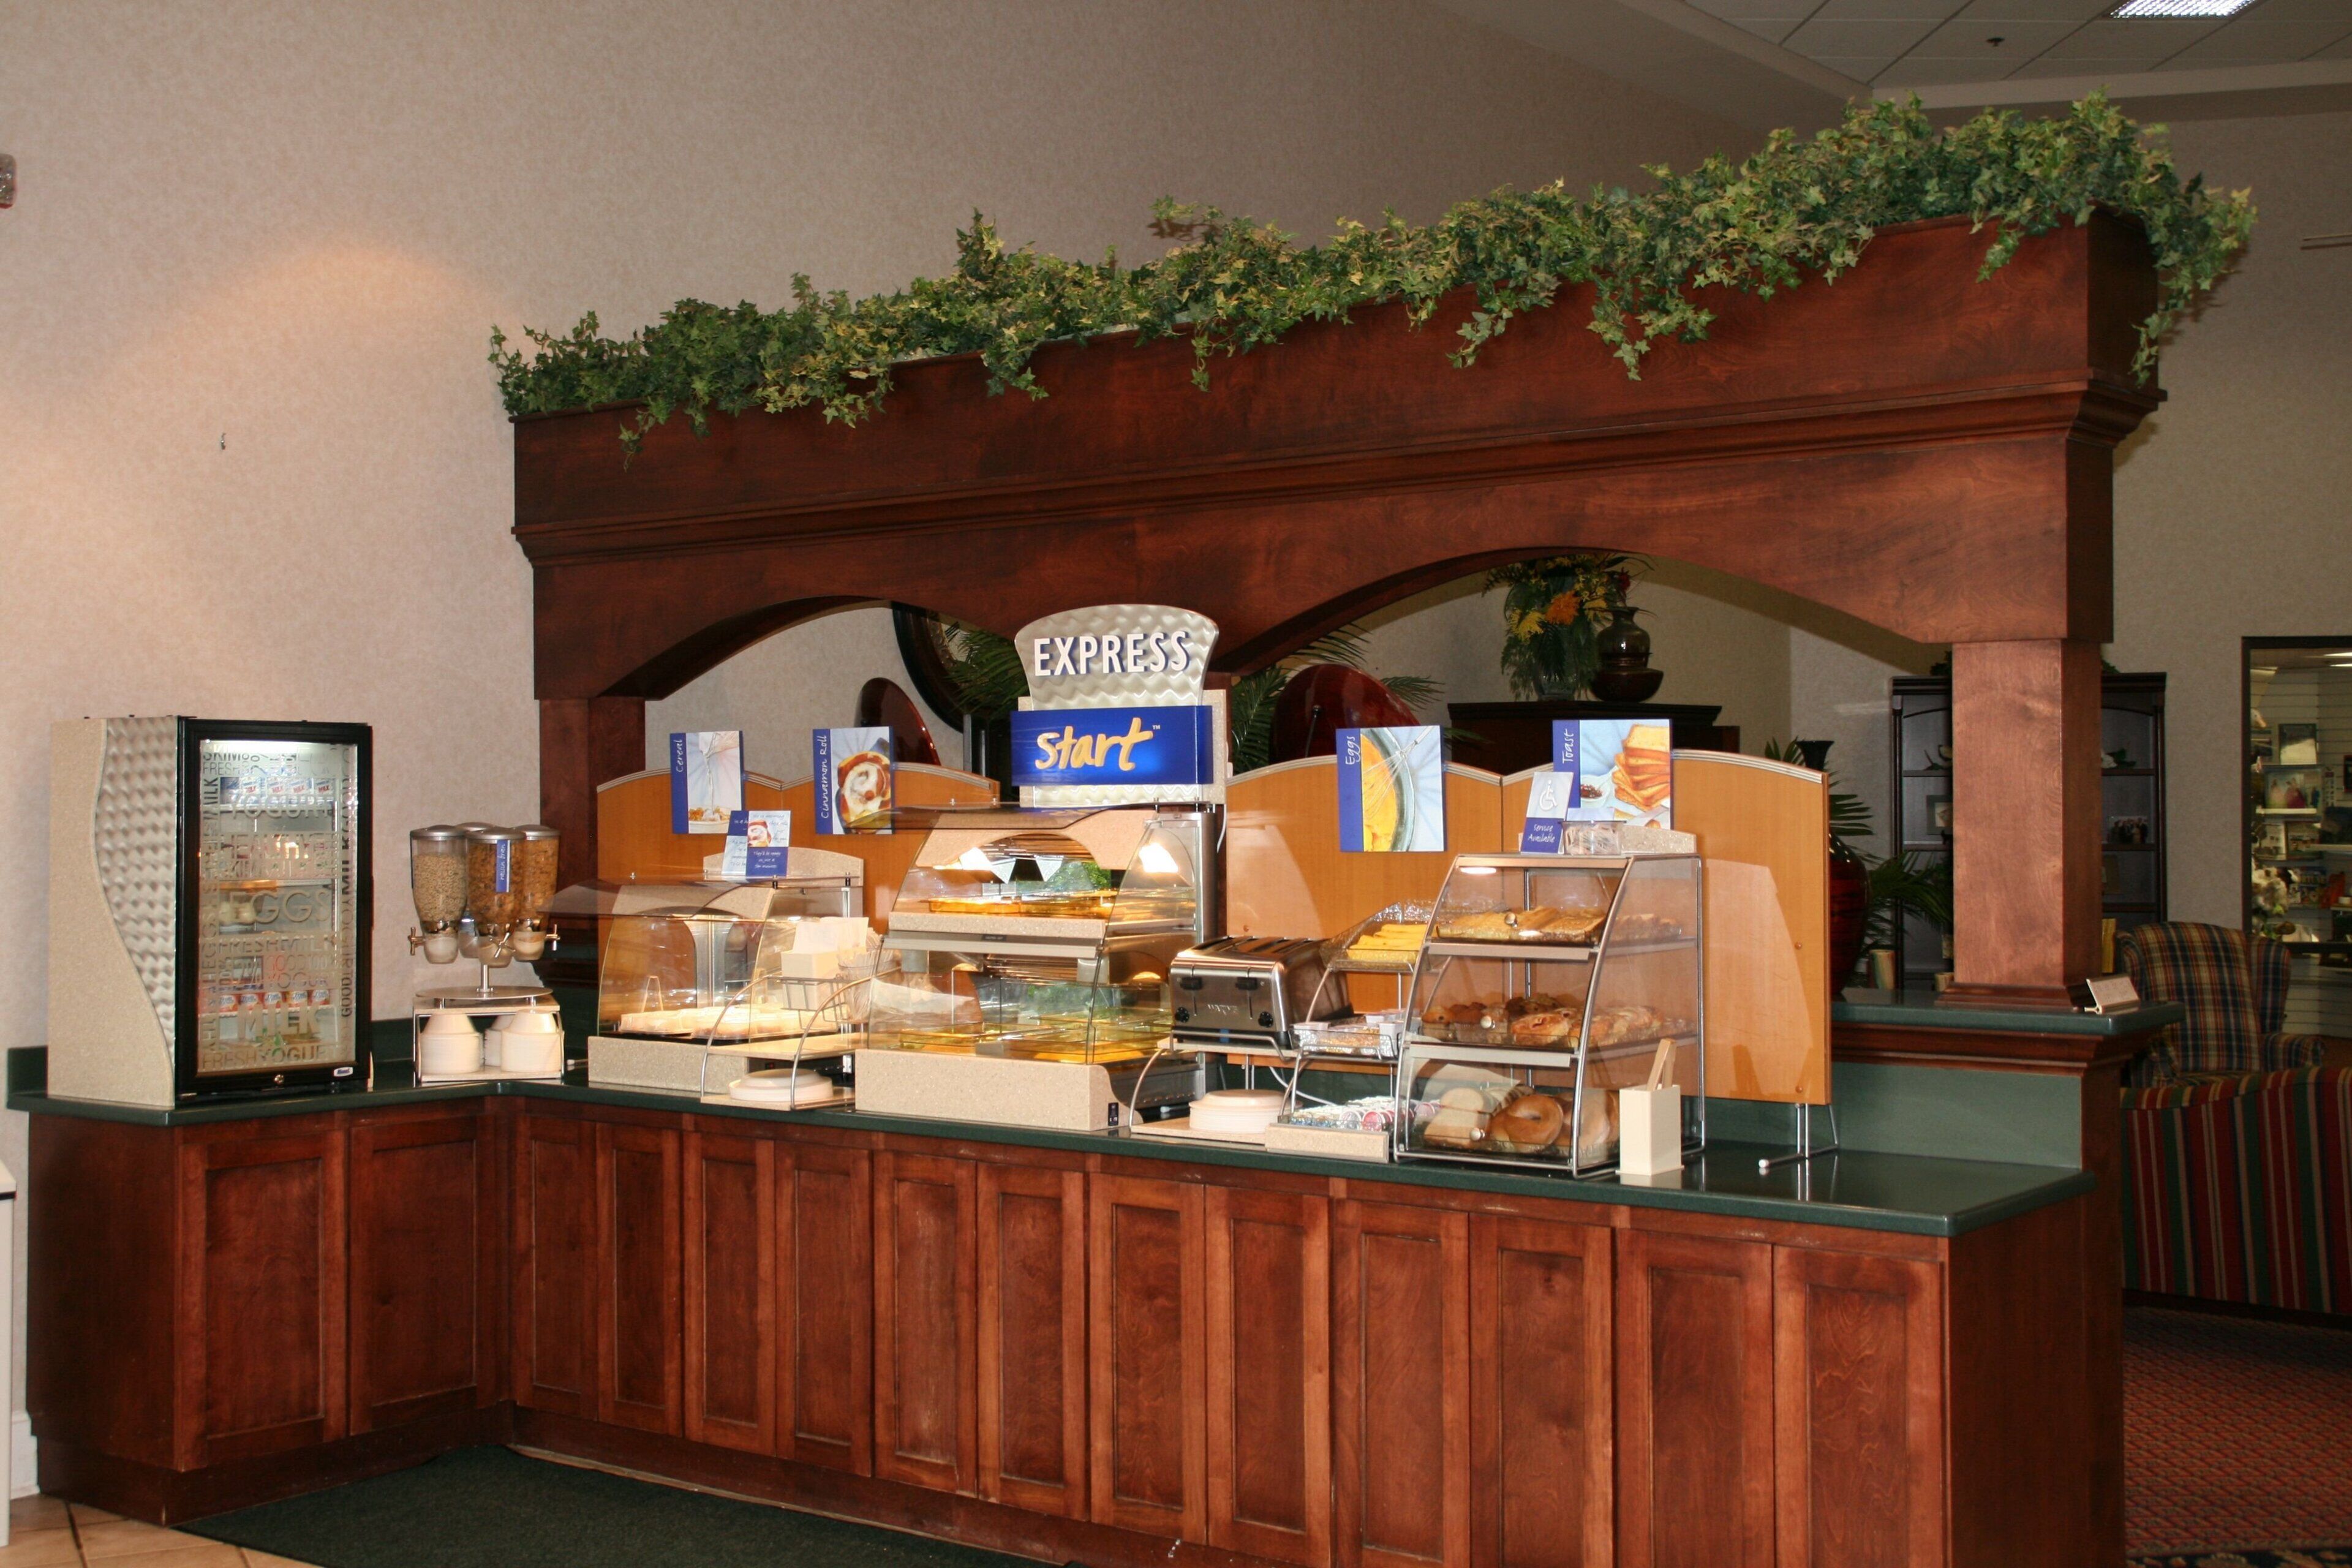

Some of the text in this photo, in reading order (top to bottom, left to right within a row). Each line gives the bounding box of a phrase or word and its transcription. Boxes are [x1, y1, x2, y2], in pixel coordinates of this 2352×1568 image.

[1034, 631, 1191, 676] EXPRESS
[673, 739, 684, 772] Cereal
[1035, 717, 1154, 772] Start
[1345, 736, 1360, 765] Eggs
[1562, 728, 1574, 764] Toast
[816, 735, 829, 818] Cinnamon Roll
[1528, 833, 1556, 843] Available
[1533, 824, 1554, 832] Service
[228, 889, 330, 925] EGGS
